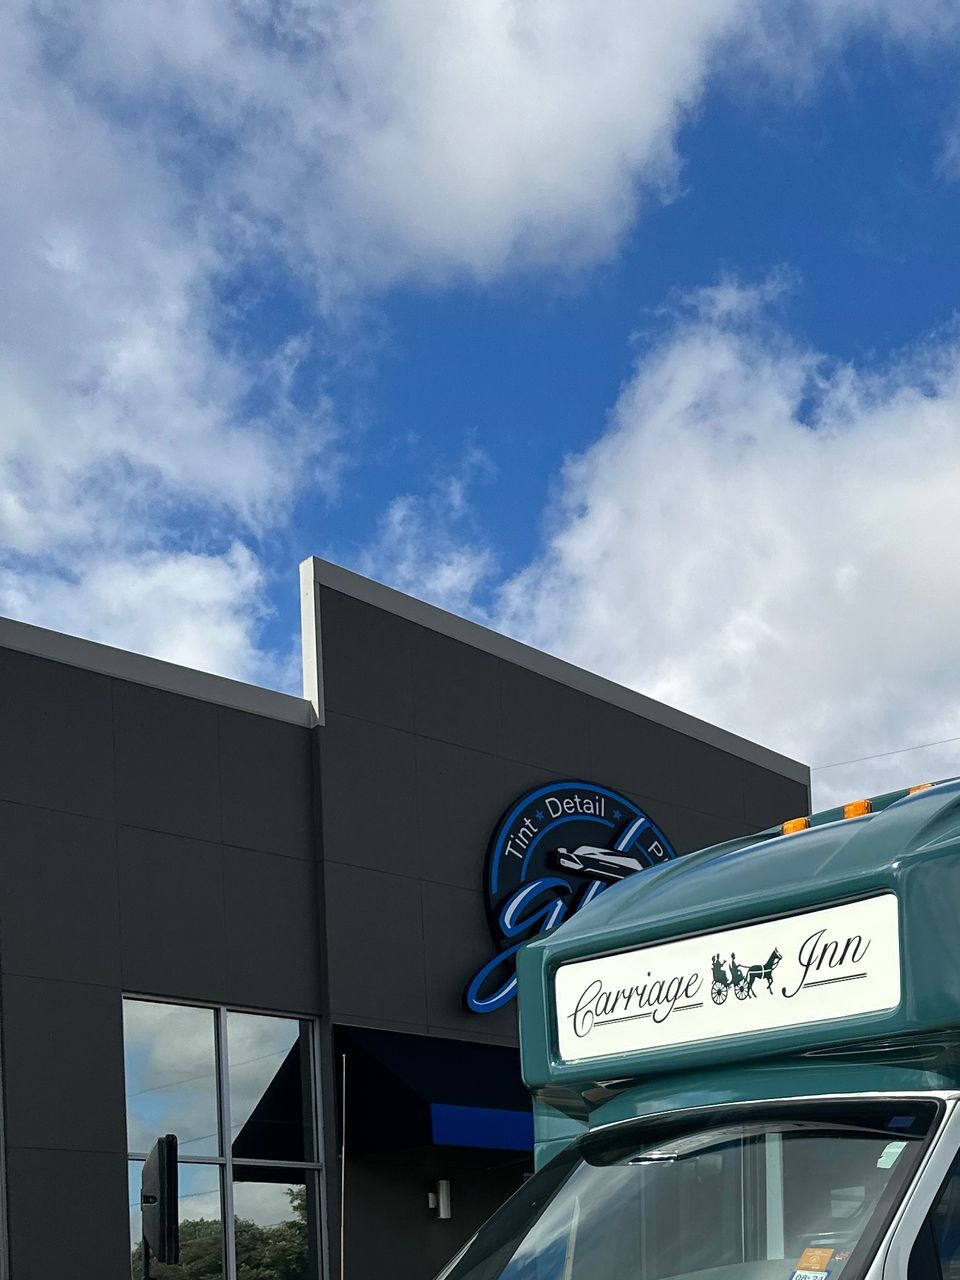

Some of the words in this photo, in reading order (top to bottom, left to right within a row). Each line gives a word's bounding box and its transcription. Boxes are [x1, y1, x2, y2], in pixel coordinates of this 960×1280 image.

[504, 817, 538, 859] Tint
[545, 794, 605, 818] Detail
[567, 971, 704, 1038] Carriage
[781, 928, 872, 999] Inn
